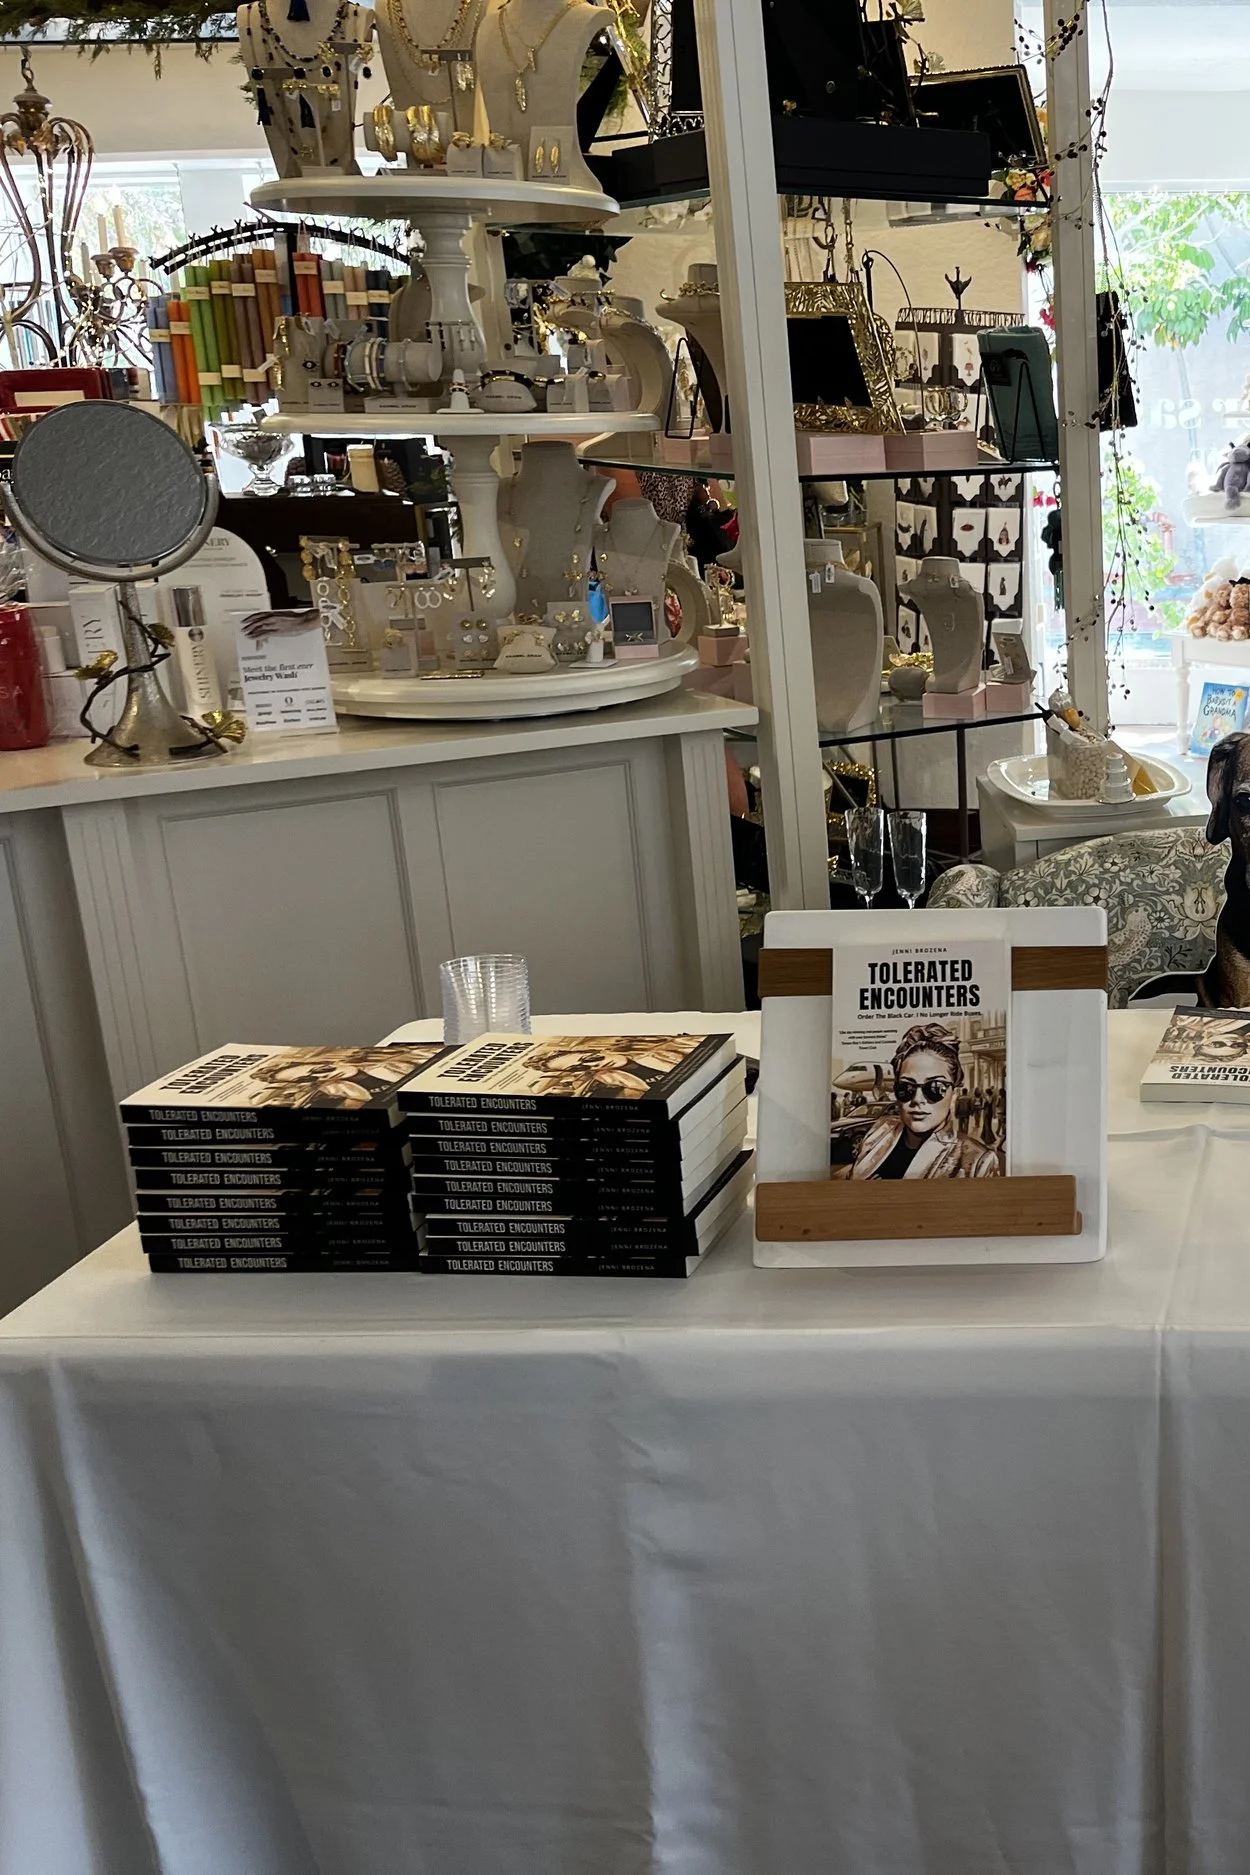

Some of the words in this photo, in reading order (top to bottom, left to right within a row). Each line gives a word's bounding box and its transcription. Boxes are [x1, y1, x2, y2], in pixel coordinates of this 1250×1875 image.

[264, 664, 277, 672] the
[244, 672, 274, 683] Jewelry
[1227, 689, 1236, 697] TO
[1207, 694, 1231, 706] BABYSIT
[1203, 704, 1237, 721] GRANDMA
[868, 959, 973, 985] TOLERATED
[859, 984, 980, 1010] ENCOUNTERS
[930, 1011, 949, 1019] Longer
[437, 1042, 508, 1078] TOLERATED
[457, 1042, 535, 1082] ENCOUNTERS
[159, 1055, 241, 1090] TOLERATED
[179, 1054, 269, 1094] ENCOUNTERS
[428, 1096, 477, 1108] TOLERATED
[481, 1097, 537, 1110] ENCOUNTERS
[149, 1109, 198, 1121] TOLERATED
[201, 1110, 257, 1123] ENCOUNTERS
[438, 1120, 488, 1132] TOLERATED
[491, 1121, 548, 1134] ENCOUNTERS
[161, 1129, 212, 1141] TOLERATED
[216, 1128, 275, 1140] ENCOUNTERS
[437, 1140, 487, 1153] TOLERATED
[490, 1142, 547, 1154] ENCOUNTERS
[162, 1151, 211, 1163] TOLERATED
[215, 1152, 272, 1164] ENCOUNTERS
[444, 1160, 493, 1172] TOLERATED
[496, 1161, 552, 1173] ENCOUNTERS
[170, 1173, 220, 1185] TOLERATED
[224, 1173, 281, 1185] ENCOUNTERS
[445, 1180, 494, 1192] TOLERATED
[497, 1181, 553, 1194] ENCOUNTERS
[166, 1198, 216, 1209] TOLERATED
[219, 1198, 277, 1209] ENCOUNTERS
[444, 1199, 493, 1211] TOLERATED
[496, 1199, 552, 1212] ENCOUNTERS
[168, 1218, 218, 1230] TOLERATED
[222, 1217, 280, 1230] ENCOUNTERS
[456, 1221, 506, 1234] TOLERATED
[509, 1222, 565, 1234] ENCOUNTERS
[171, 1238, 221, 1250] TOLERATED
[224, 1237, 282, 1249] ENCOUNTERS
[456, 1240, 506, 1253] TOLERATED
[509, 1240, 566, 1253] ENCOUNTERS
[177, 1257, 227, 1269] TOLERATED
[230, 1257, 287, 1268] ENCOUNTERS
[446, 1259, 495, 1271] TOLERATED
[498, 1259, 554, 1272] ENCOUNTERS
